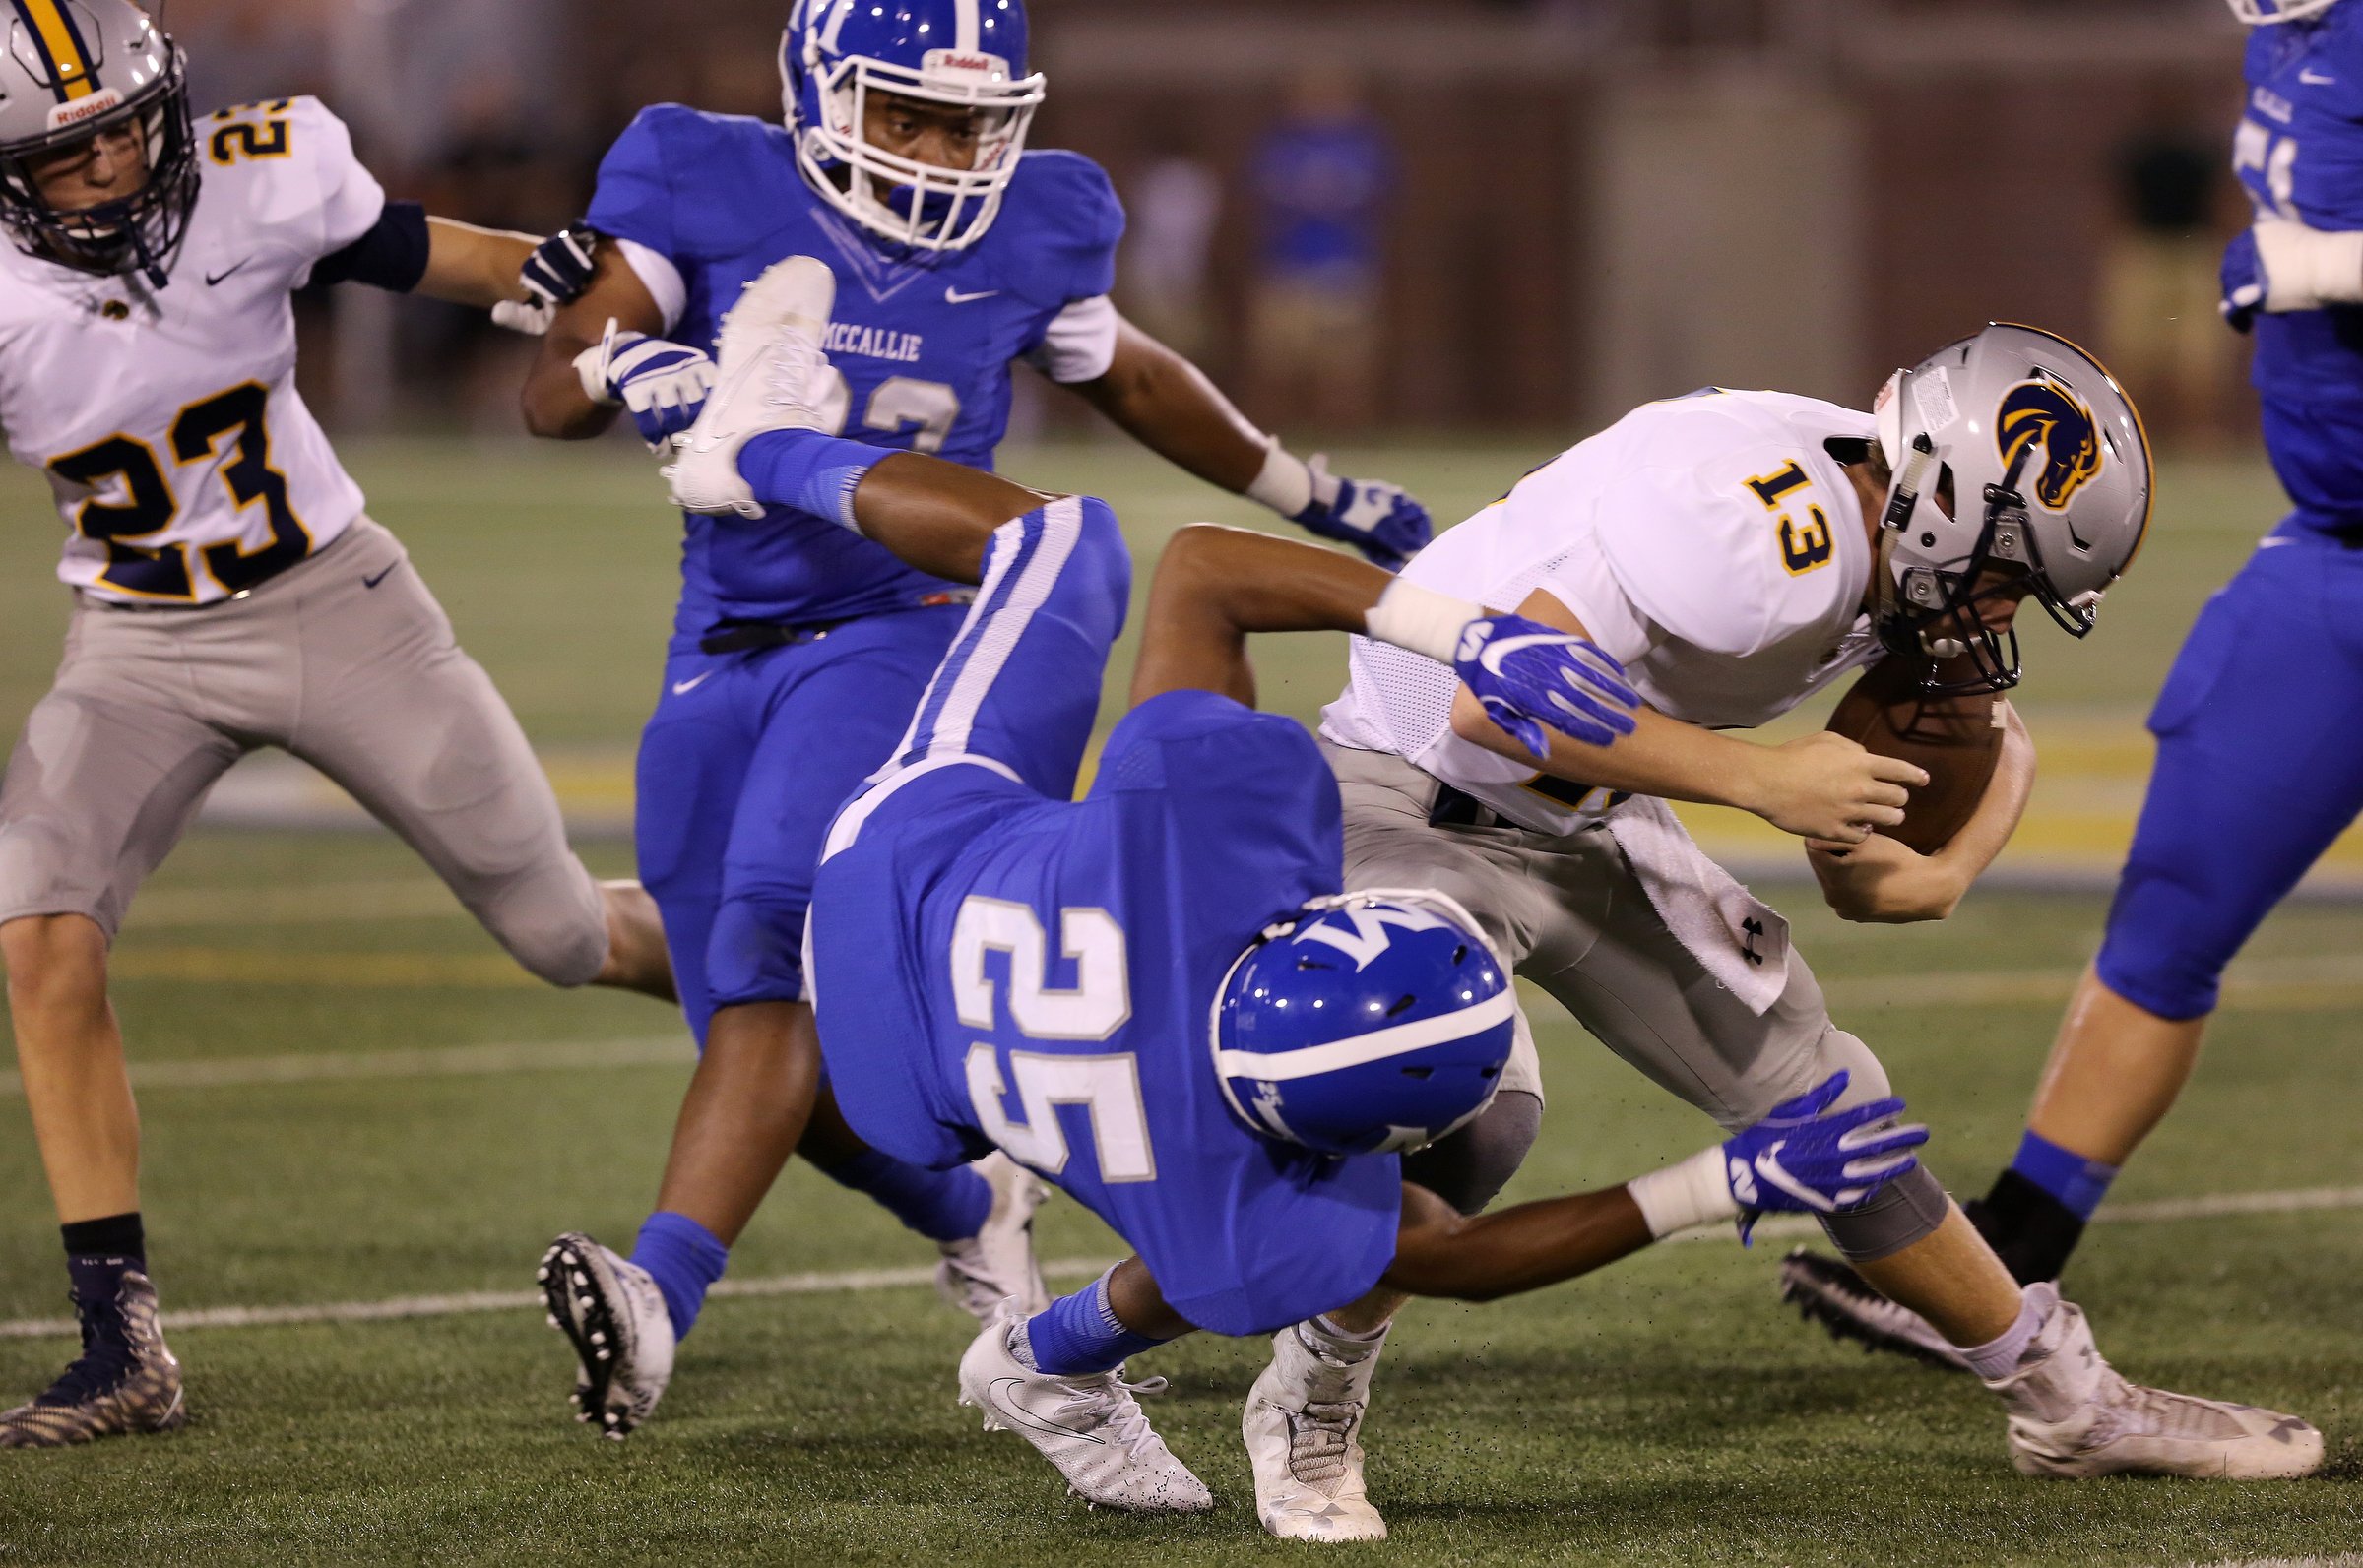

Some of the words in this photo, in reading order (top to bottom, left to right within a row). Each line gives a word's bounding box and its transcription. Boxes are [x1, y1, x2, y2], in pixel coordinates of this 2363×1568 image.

[56, 95, 117, 125] Riddell
[47, 378, 313, 602] 23
[1740, 458, 1836, 578] 13
[950, 894, 1158, 1184] 25
